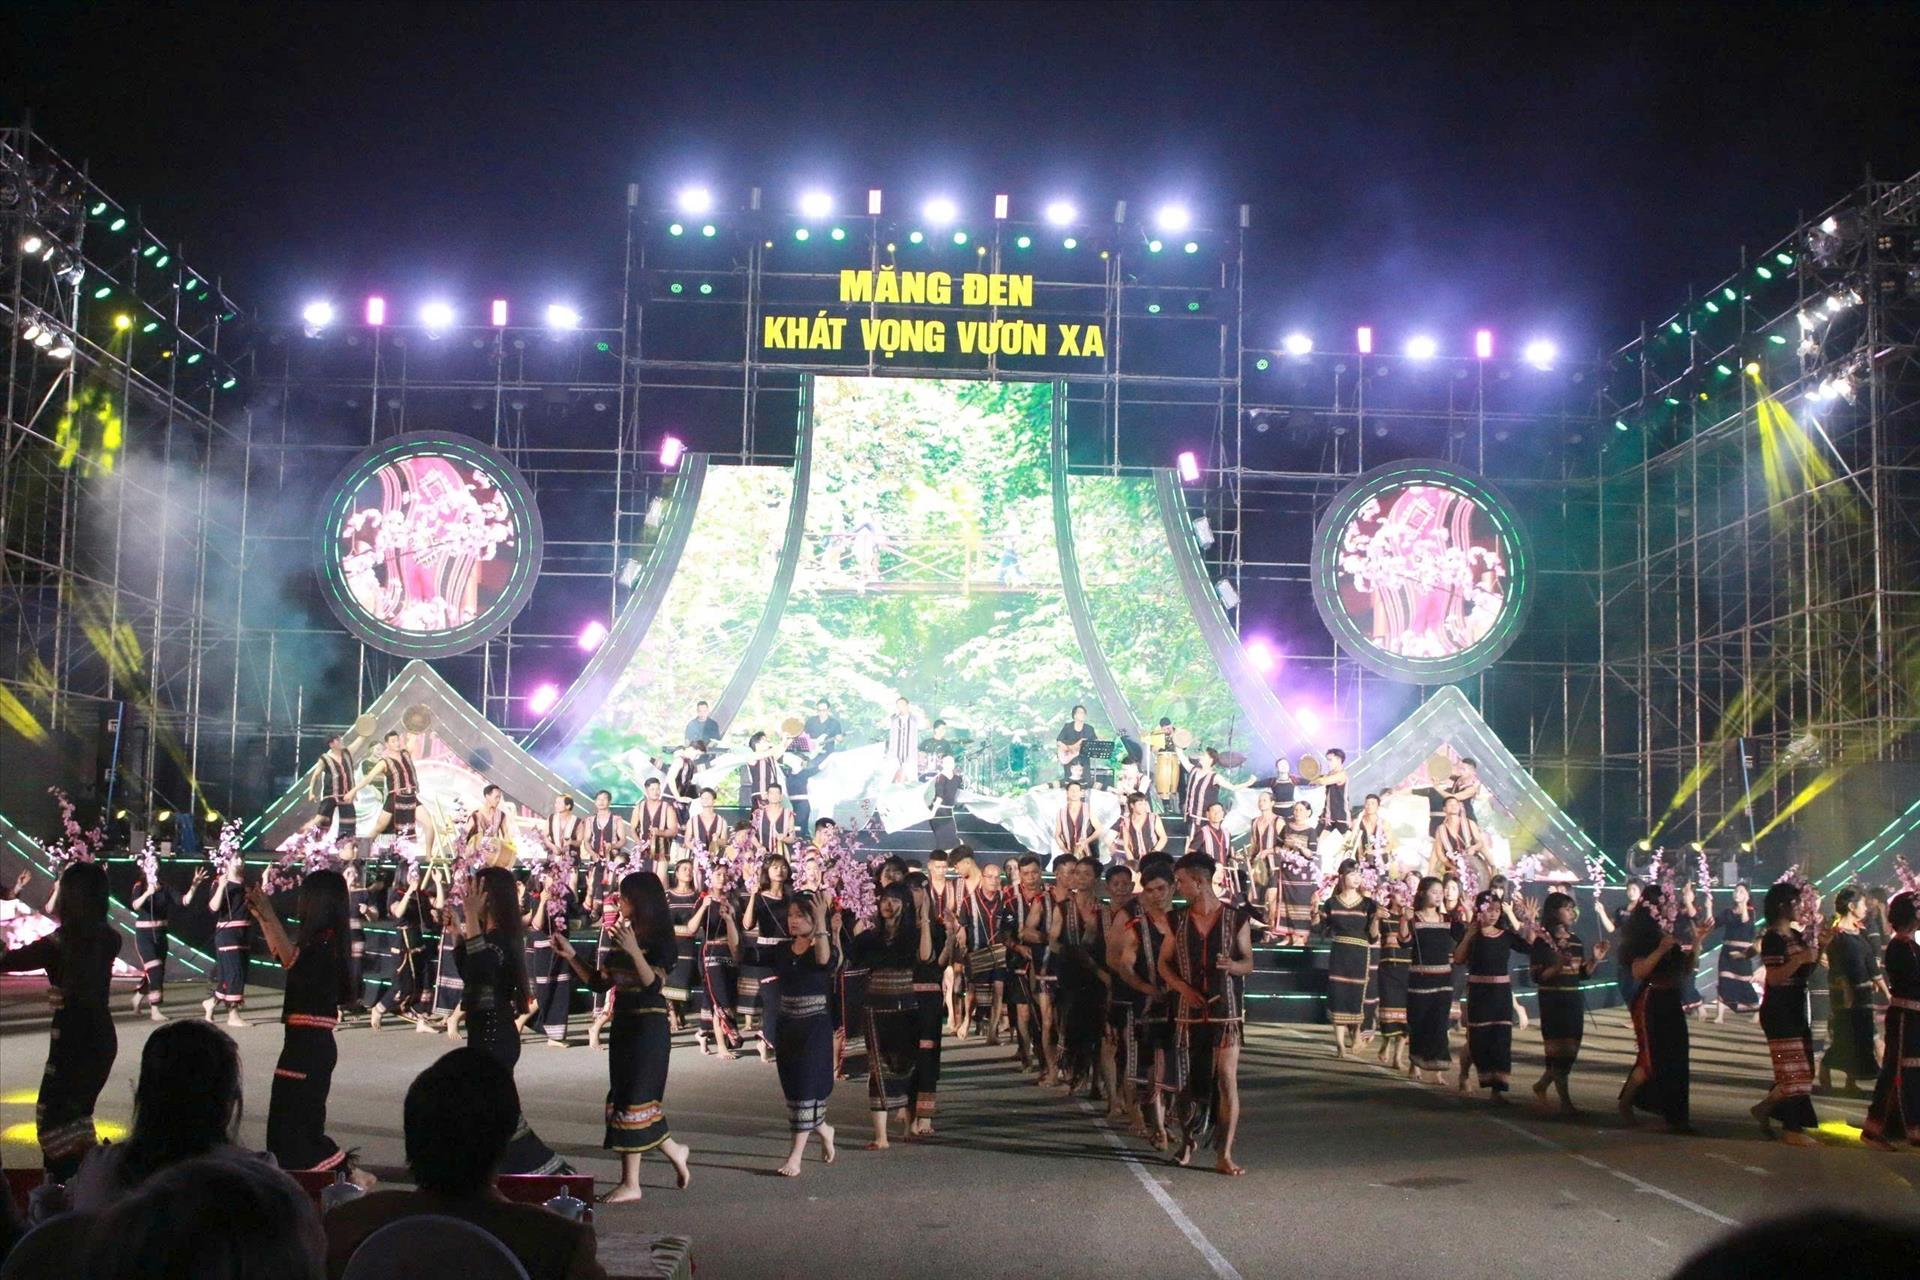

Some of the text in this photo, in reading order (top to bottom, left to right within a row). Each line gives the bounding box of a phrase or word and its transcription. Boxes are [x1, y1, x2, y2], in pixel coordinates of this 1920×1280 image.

[839, 264, 1034, 307] MĂNG ĐEN
[763, 310, 1106, 359] KHÁT VỌNG VƯƠN XA
